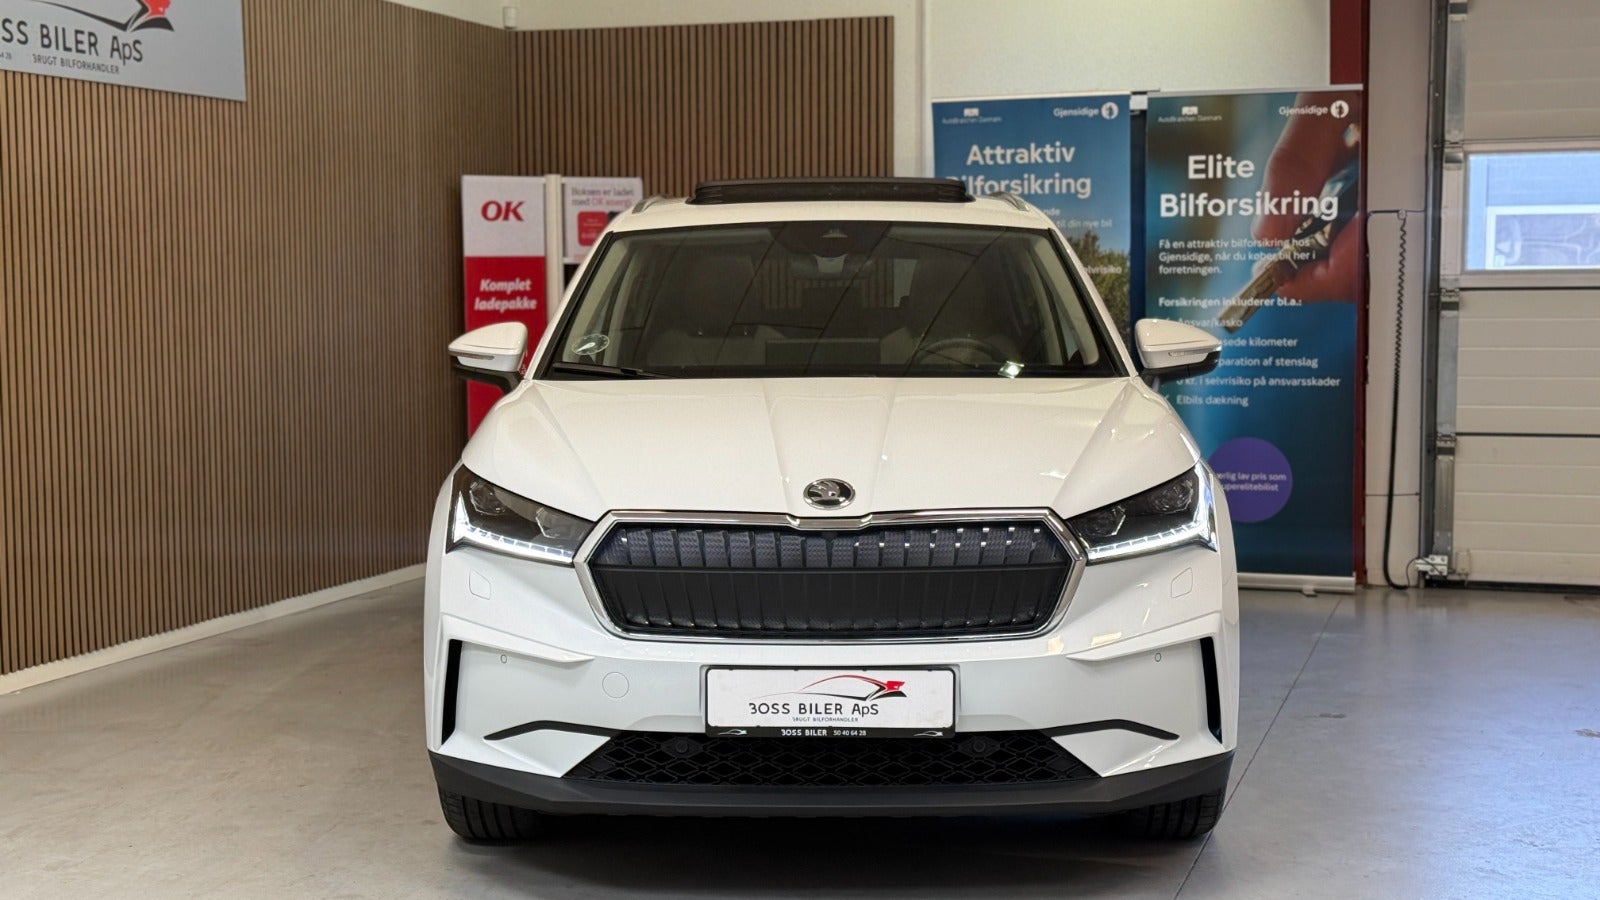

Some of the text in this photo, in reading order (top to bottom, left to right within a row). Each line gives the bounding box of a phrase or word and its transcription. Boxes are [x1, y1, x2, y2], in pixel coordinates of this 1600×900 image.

[2, 18, 144, 66] SS BILER ApS
[60, 58, 119, 74] BILFORHANDLER
[1053, 107, 1099, 118] Gjensidige
[1279, 105, 1328, 116] Gjensidige
[966, 142, 1076, 165] Attraktiv
[1188, 154, 1254, 179] Elite
[945, 172, 1092, 199] lforsikring
[481, 200, 525, 222] OK
[1160, 190, 1338, 221] Bilforsikring
[1158, 238, 1310, 250] Få en attraktiv bilforsikring hos
[1158, 252, 1213, 264] Gjensidige,
[1215, 252, 1232, 261] når
[1234, 252, 1246, 260] du
[1278, 251, 1291, 260] bil
[1293, 251, 1310, 260] her
[1158, 264, 1222, 276] forretningen.
[480, 278, 532, 295] Komplet
[474, 297, 537, 314] ladepakke
[1158, 297, 1220, 309] Forsikringen
[1222, 296, 1275, 306] inkluderer
[1179, 317, 1243, 328] nsvar/kasko
[1249, 336, 1298, 347] kilometer
[1218, 356, 1318, 369] paration af stenslag
[1205, 376, 1251, 386] selvrisiko
[1252, 376, 1266, 388] på
[1268, 376, 1341, 387] ansvarsskader
[1176, 394, 1249, 408] Elbils dækning
[1251, 472, 1268, 482] pris
[1268, 473, 1287, 481] som
[748, 702, 879, 718] BOSS BILER ApS
